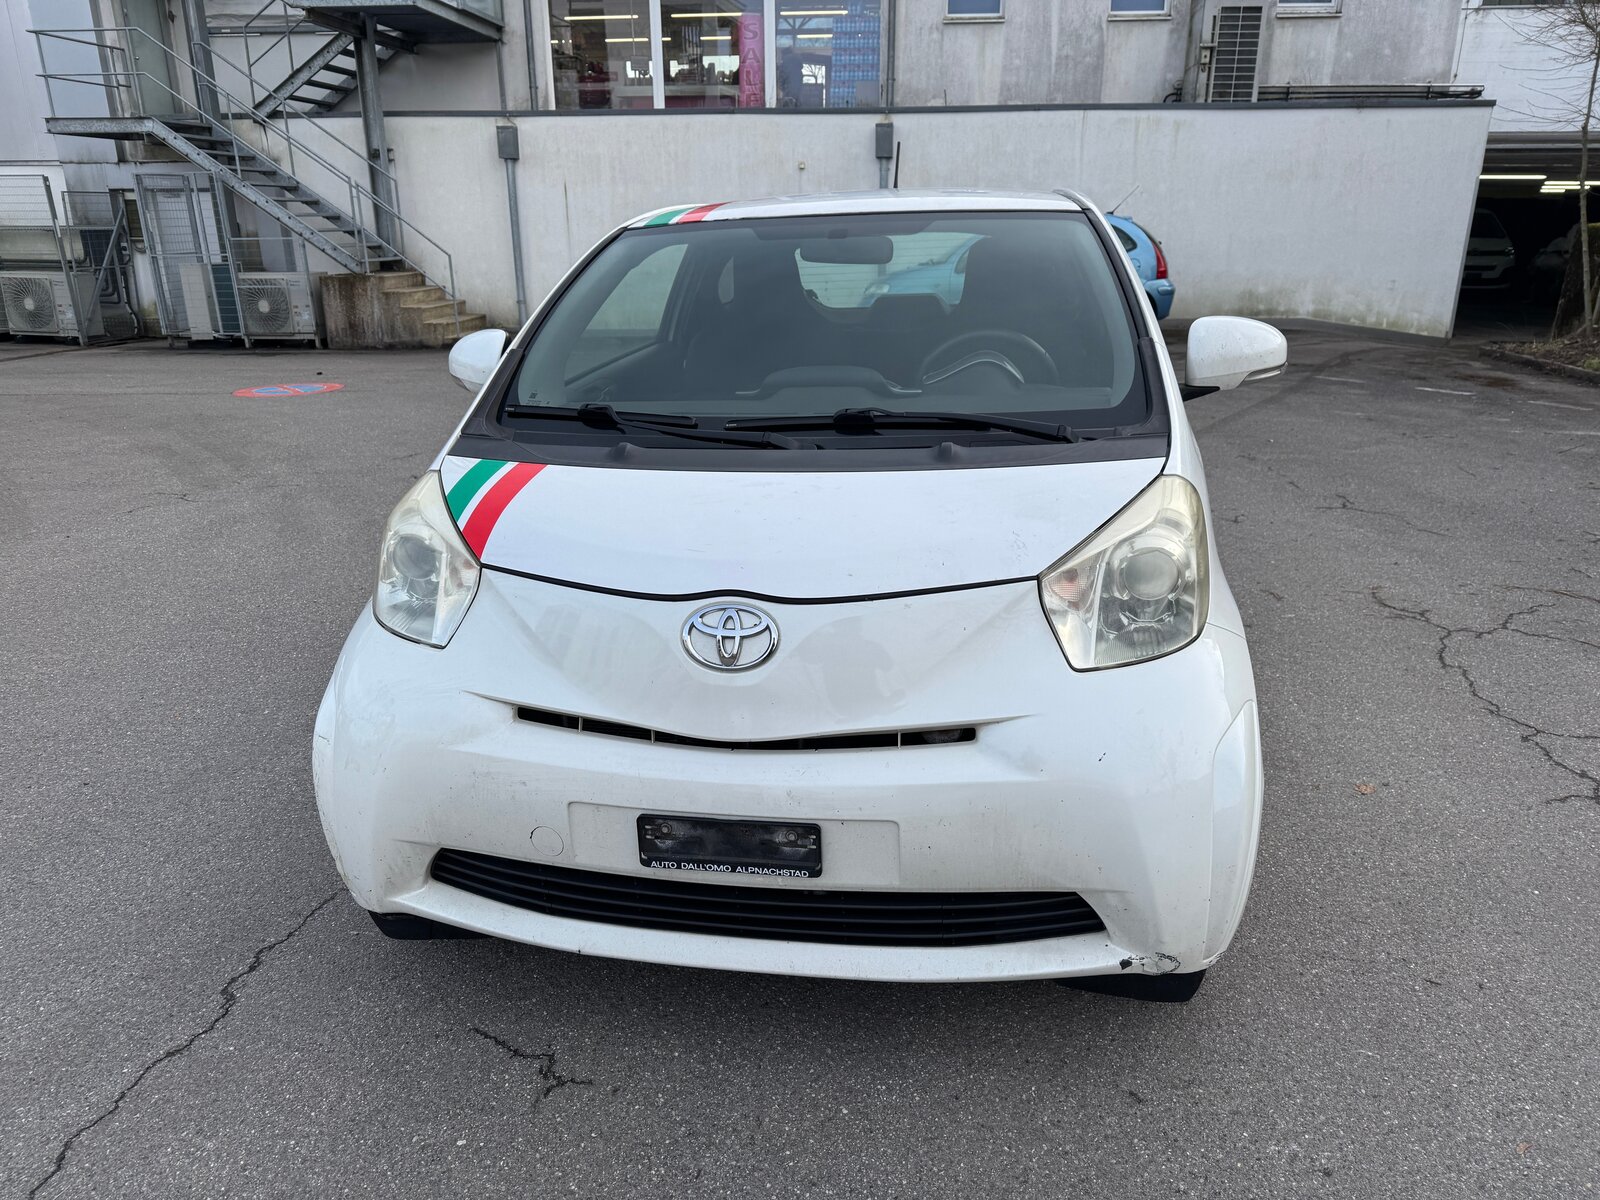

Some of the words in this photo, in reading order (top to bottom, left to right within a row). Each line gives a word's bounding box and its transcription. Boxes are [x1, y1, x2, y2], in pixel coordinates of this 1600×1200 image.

[650, 860, 678, 869] AUTO
[681, 862, 732, 873] DALL'OMO
[735, 866, 809, 878] ALPNACHSTAD
